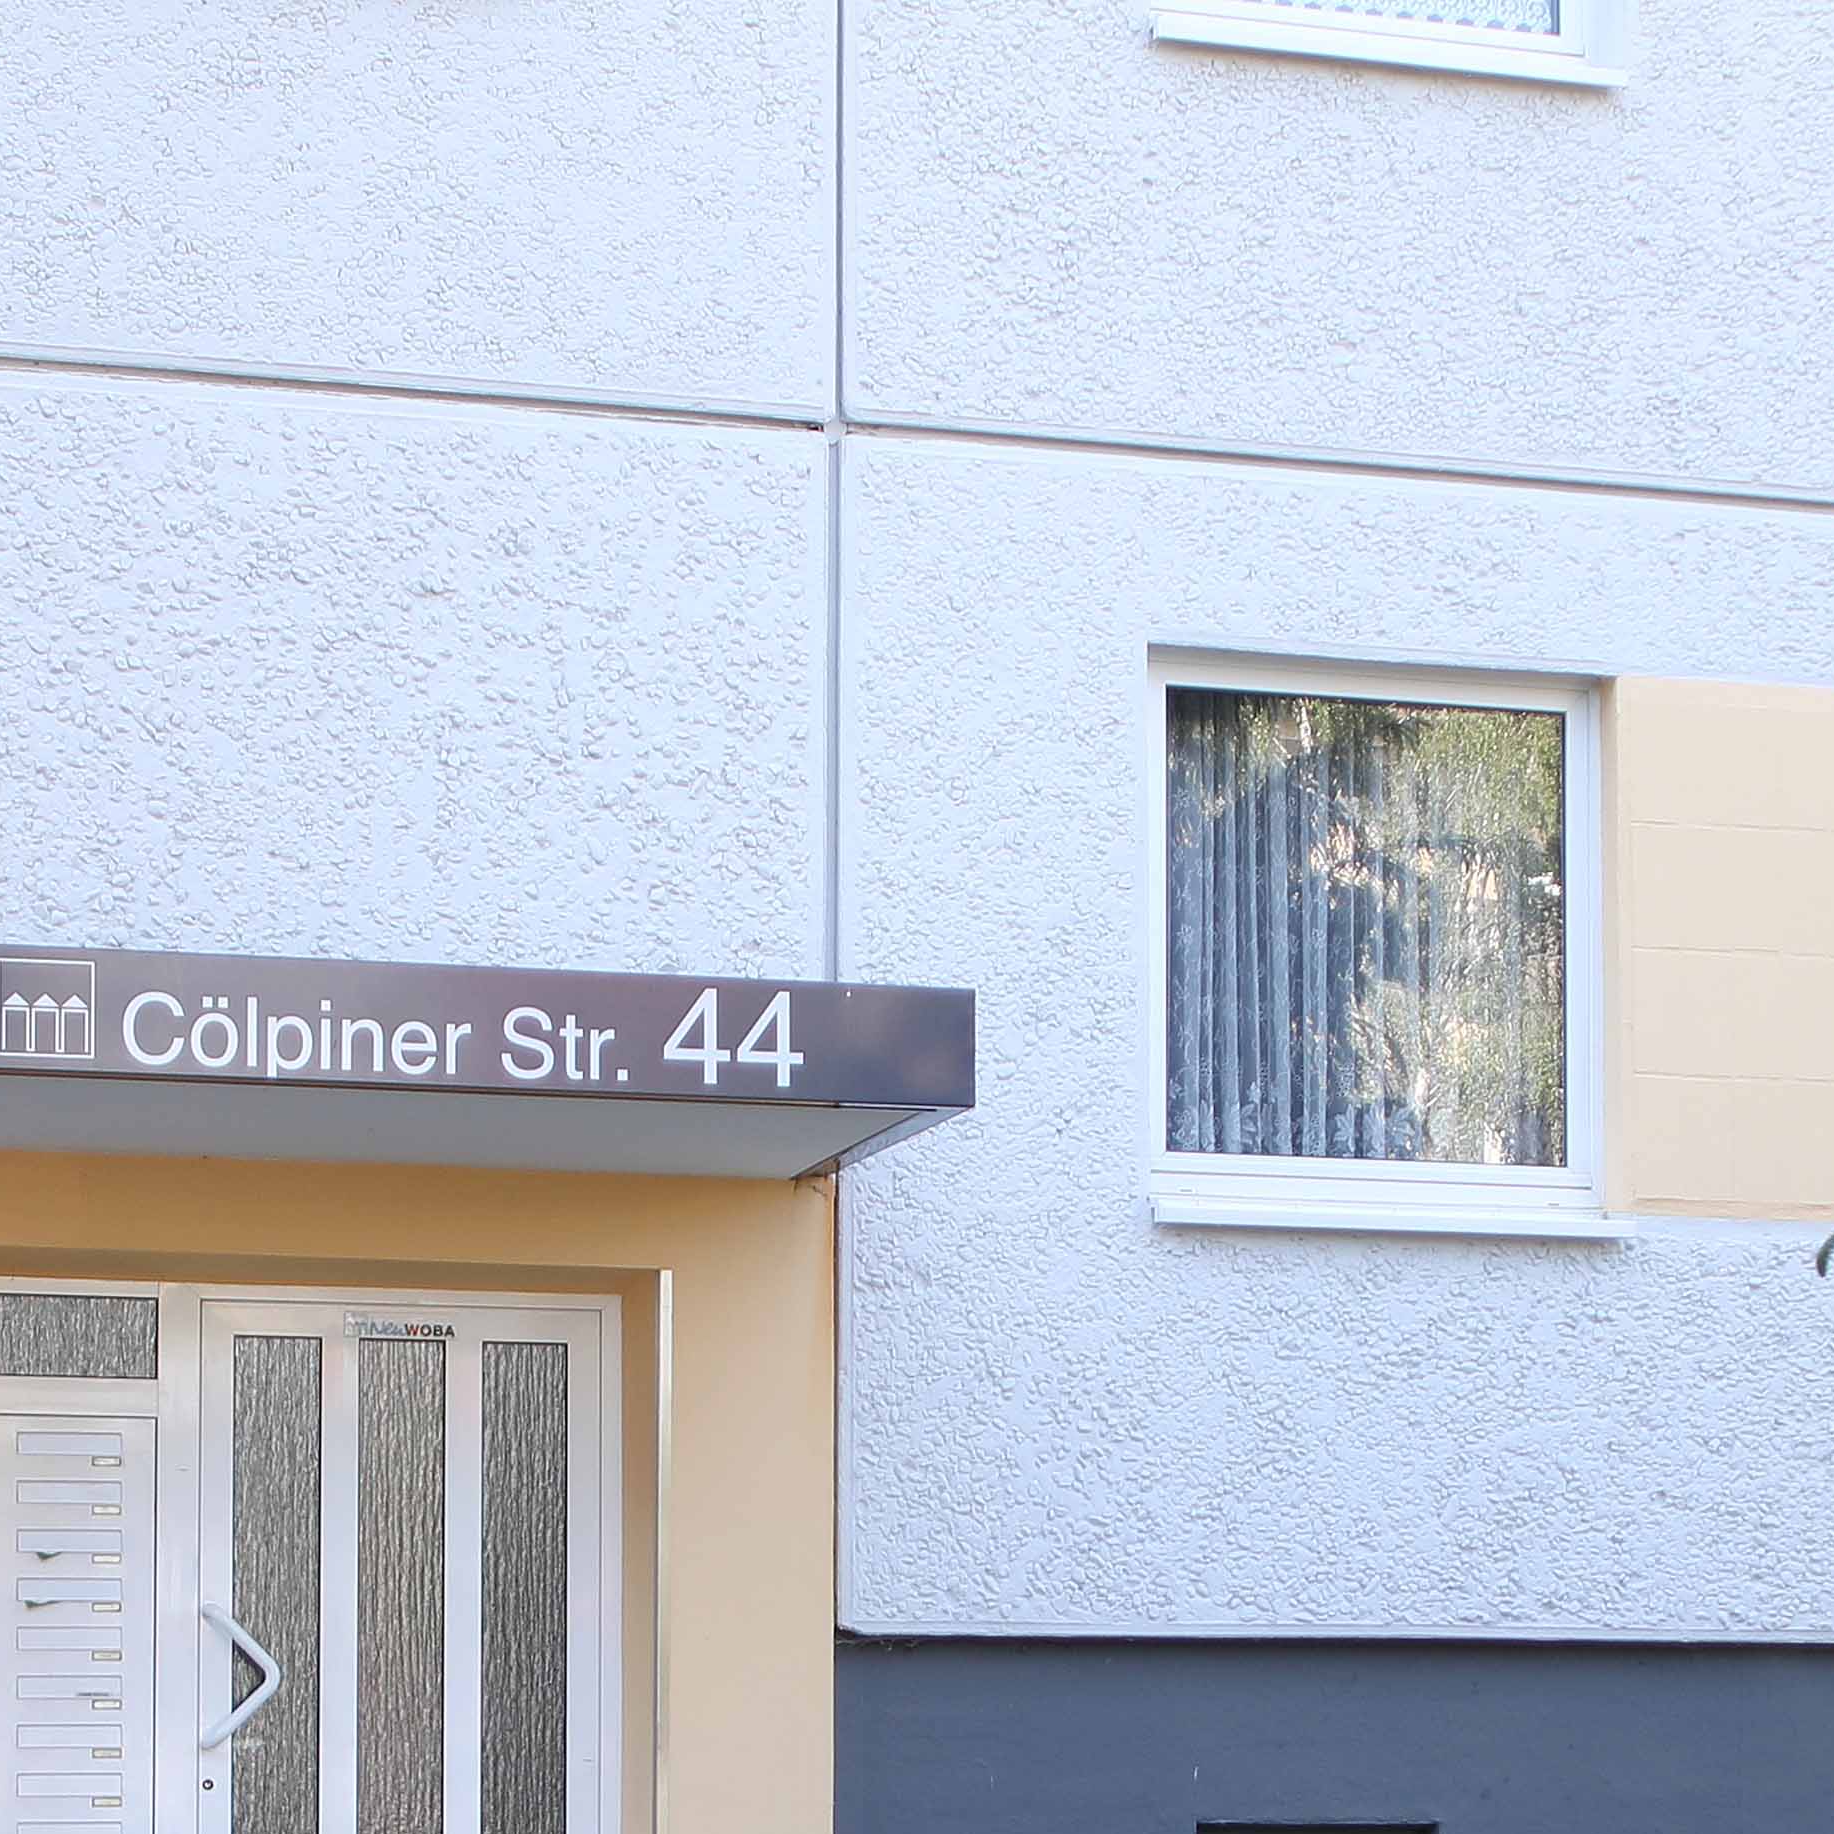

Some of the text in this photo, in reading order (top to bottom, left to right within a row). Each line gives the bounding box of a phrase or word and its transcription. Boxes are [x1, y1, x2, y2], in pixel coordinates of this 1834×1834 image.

[122, 988, 805, 1087] Cölpiner Str. 44
